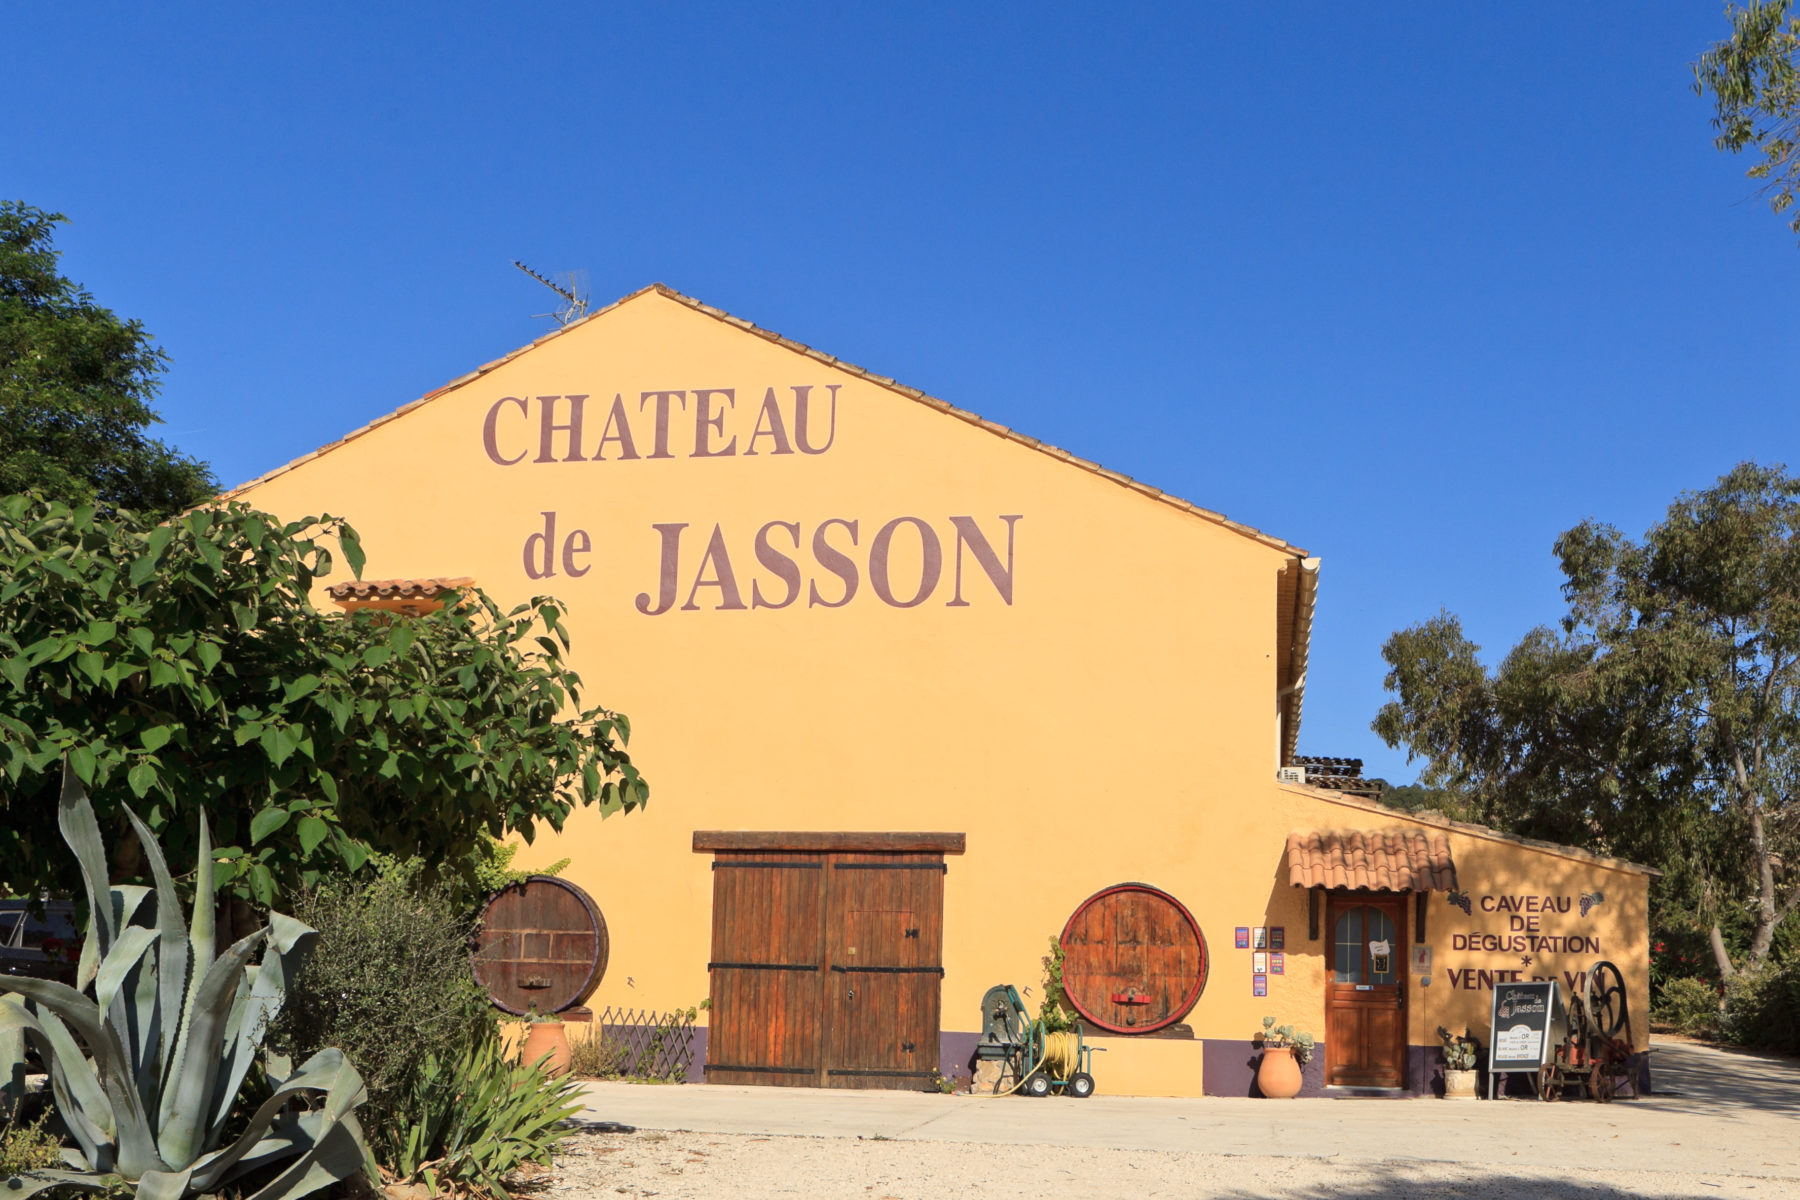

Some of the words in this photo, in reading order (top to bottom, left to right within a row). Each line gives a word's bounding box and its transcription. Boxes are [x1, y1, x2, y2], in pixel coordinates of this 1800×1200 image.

[482, 384, 843, 466] CHATEAU
[522, 511, 592, 580] de
[634, 514, 1024, 616] JASSON
[1480, 895, 1571, 913] CAVEAU
[1509, 915, 1540, 932] DE
[1452, 932, 1600, 954] DÉGUSTATION
[1447, 968, 1523, 990] VENTE
